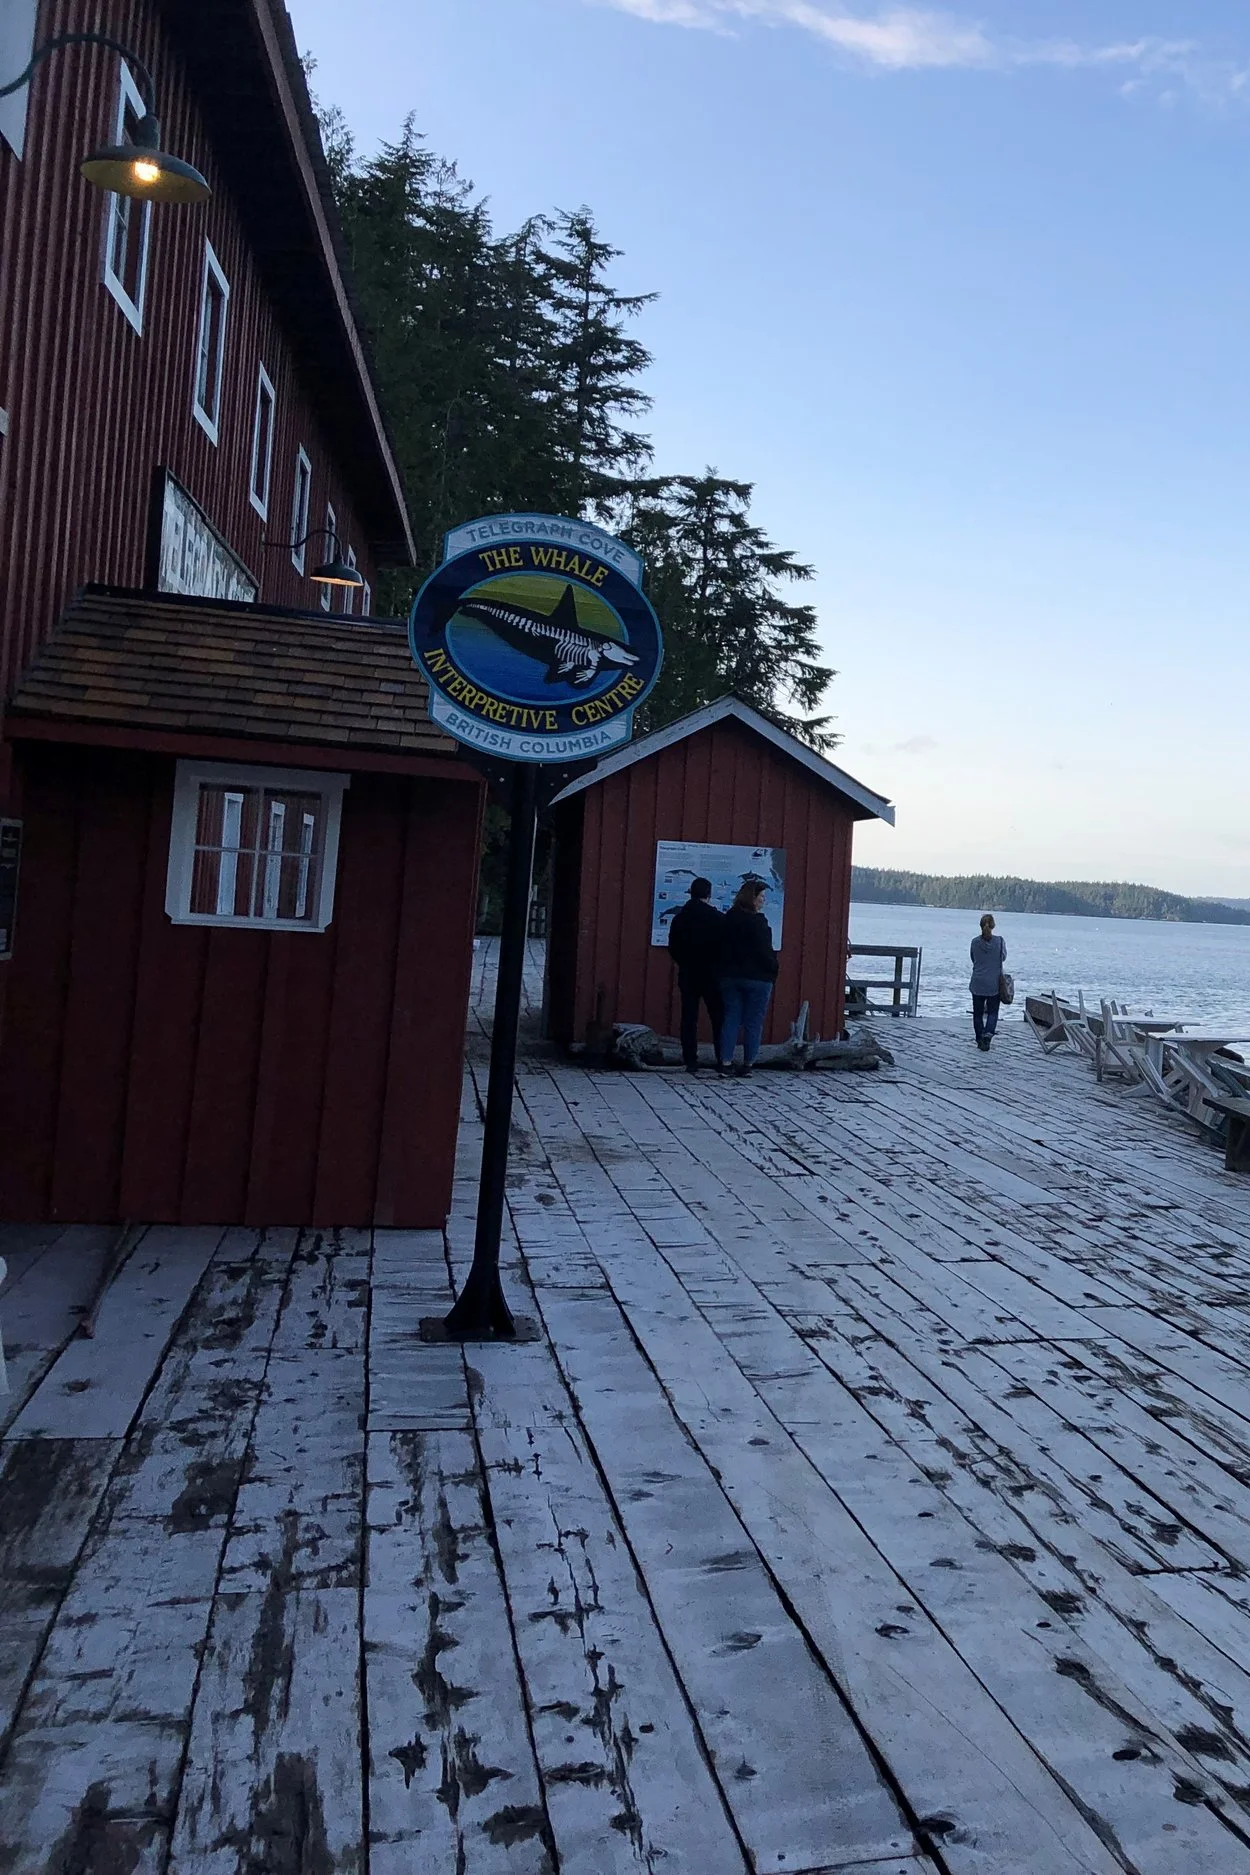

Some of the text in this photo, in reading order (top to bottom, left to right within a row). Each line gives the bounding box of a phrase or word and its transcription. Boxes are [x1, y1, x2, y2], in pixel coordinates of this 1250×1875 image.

[466, 520, 627, 563] TELEGRAPH COVE
[479, 546, 609, 587] THE WHALE
[423, 647, 645, 730] INTERPRETIVE CENTRE
[445, 712, 612, 754] BRITISH COLUMBIA
